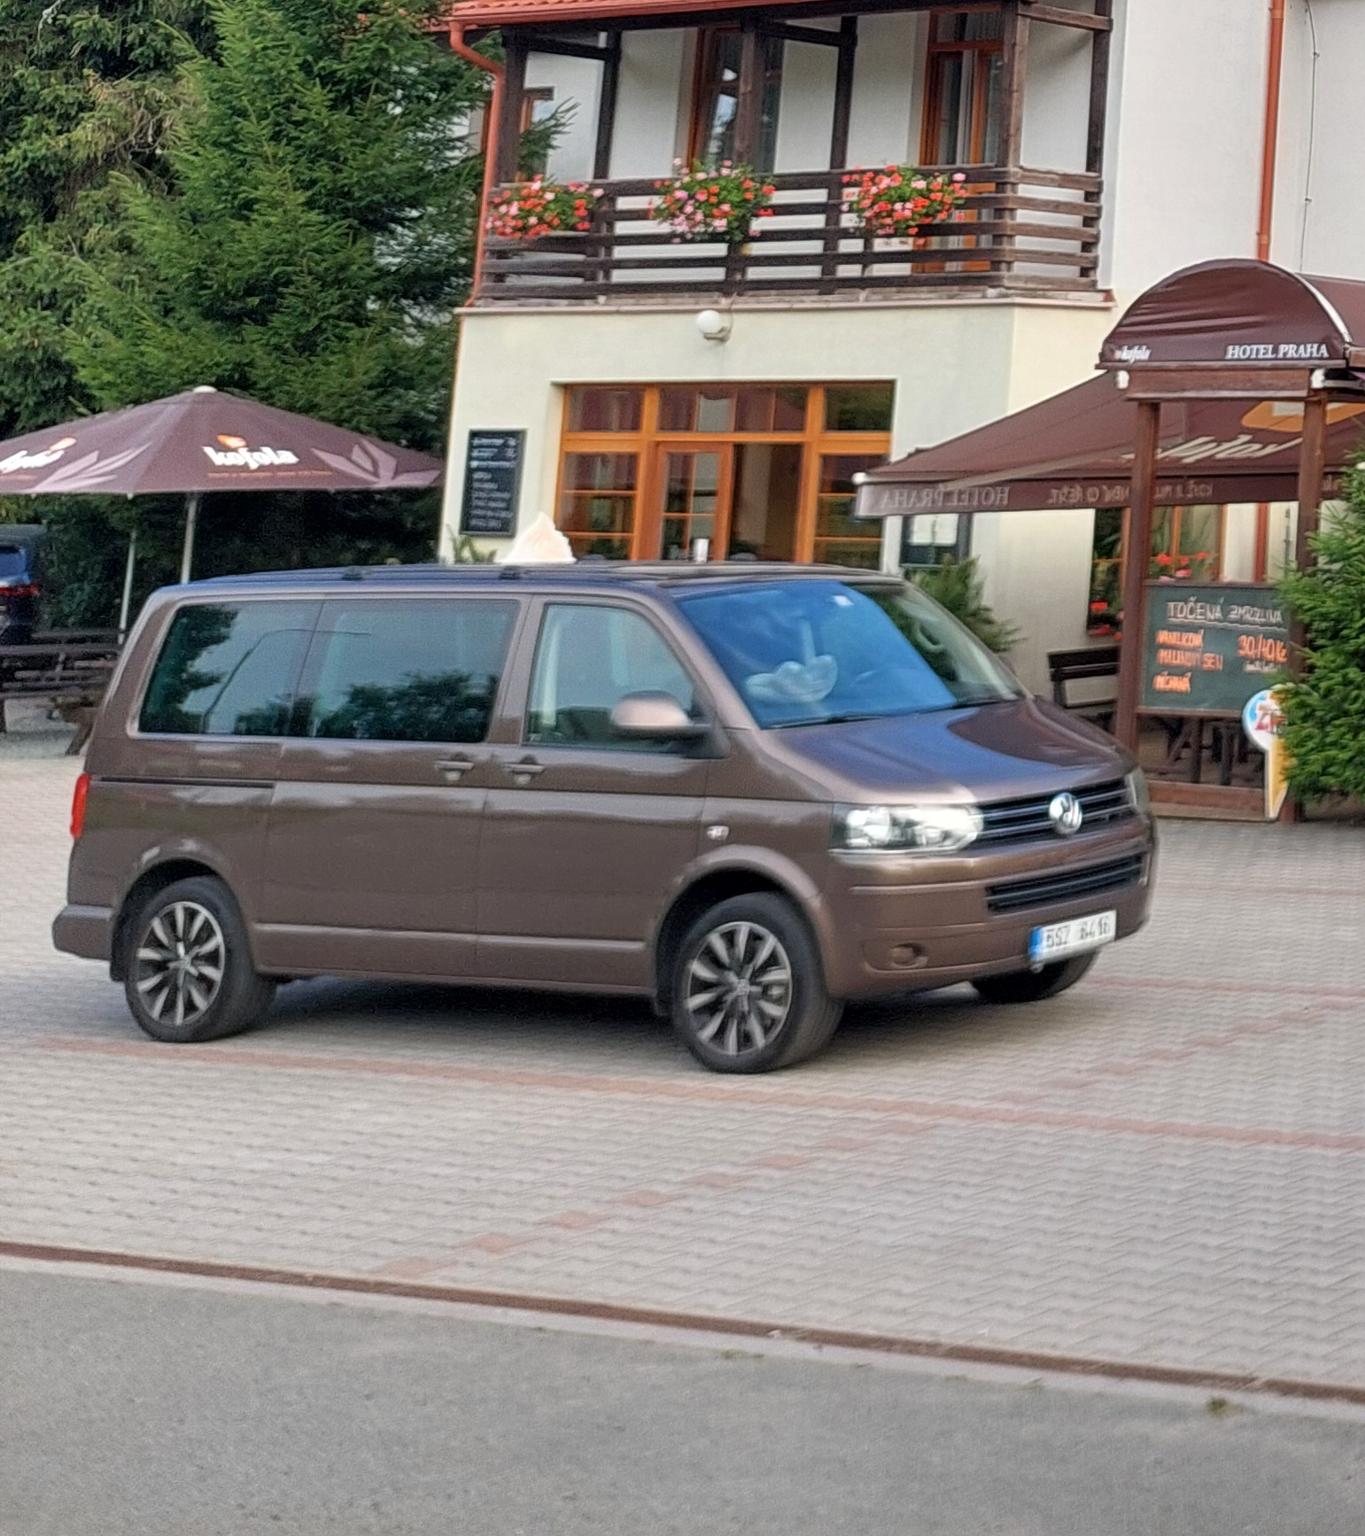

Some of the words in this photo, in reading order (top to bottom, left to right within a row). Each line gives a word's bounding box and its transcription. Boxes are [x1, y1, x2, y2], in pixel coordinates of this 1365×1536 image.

[1225, 345, 1276, 360] HOTEL
[1277, 344, 1330, 359] PRAHA
[202, 445, 300, 471] kofola
[1167, 596, 1224, 621] TOČENÁ
